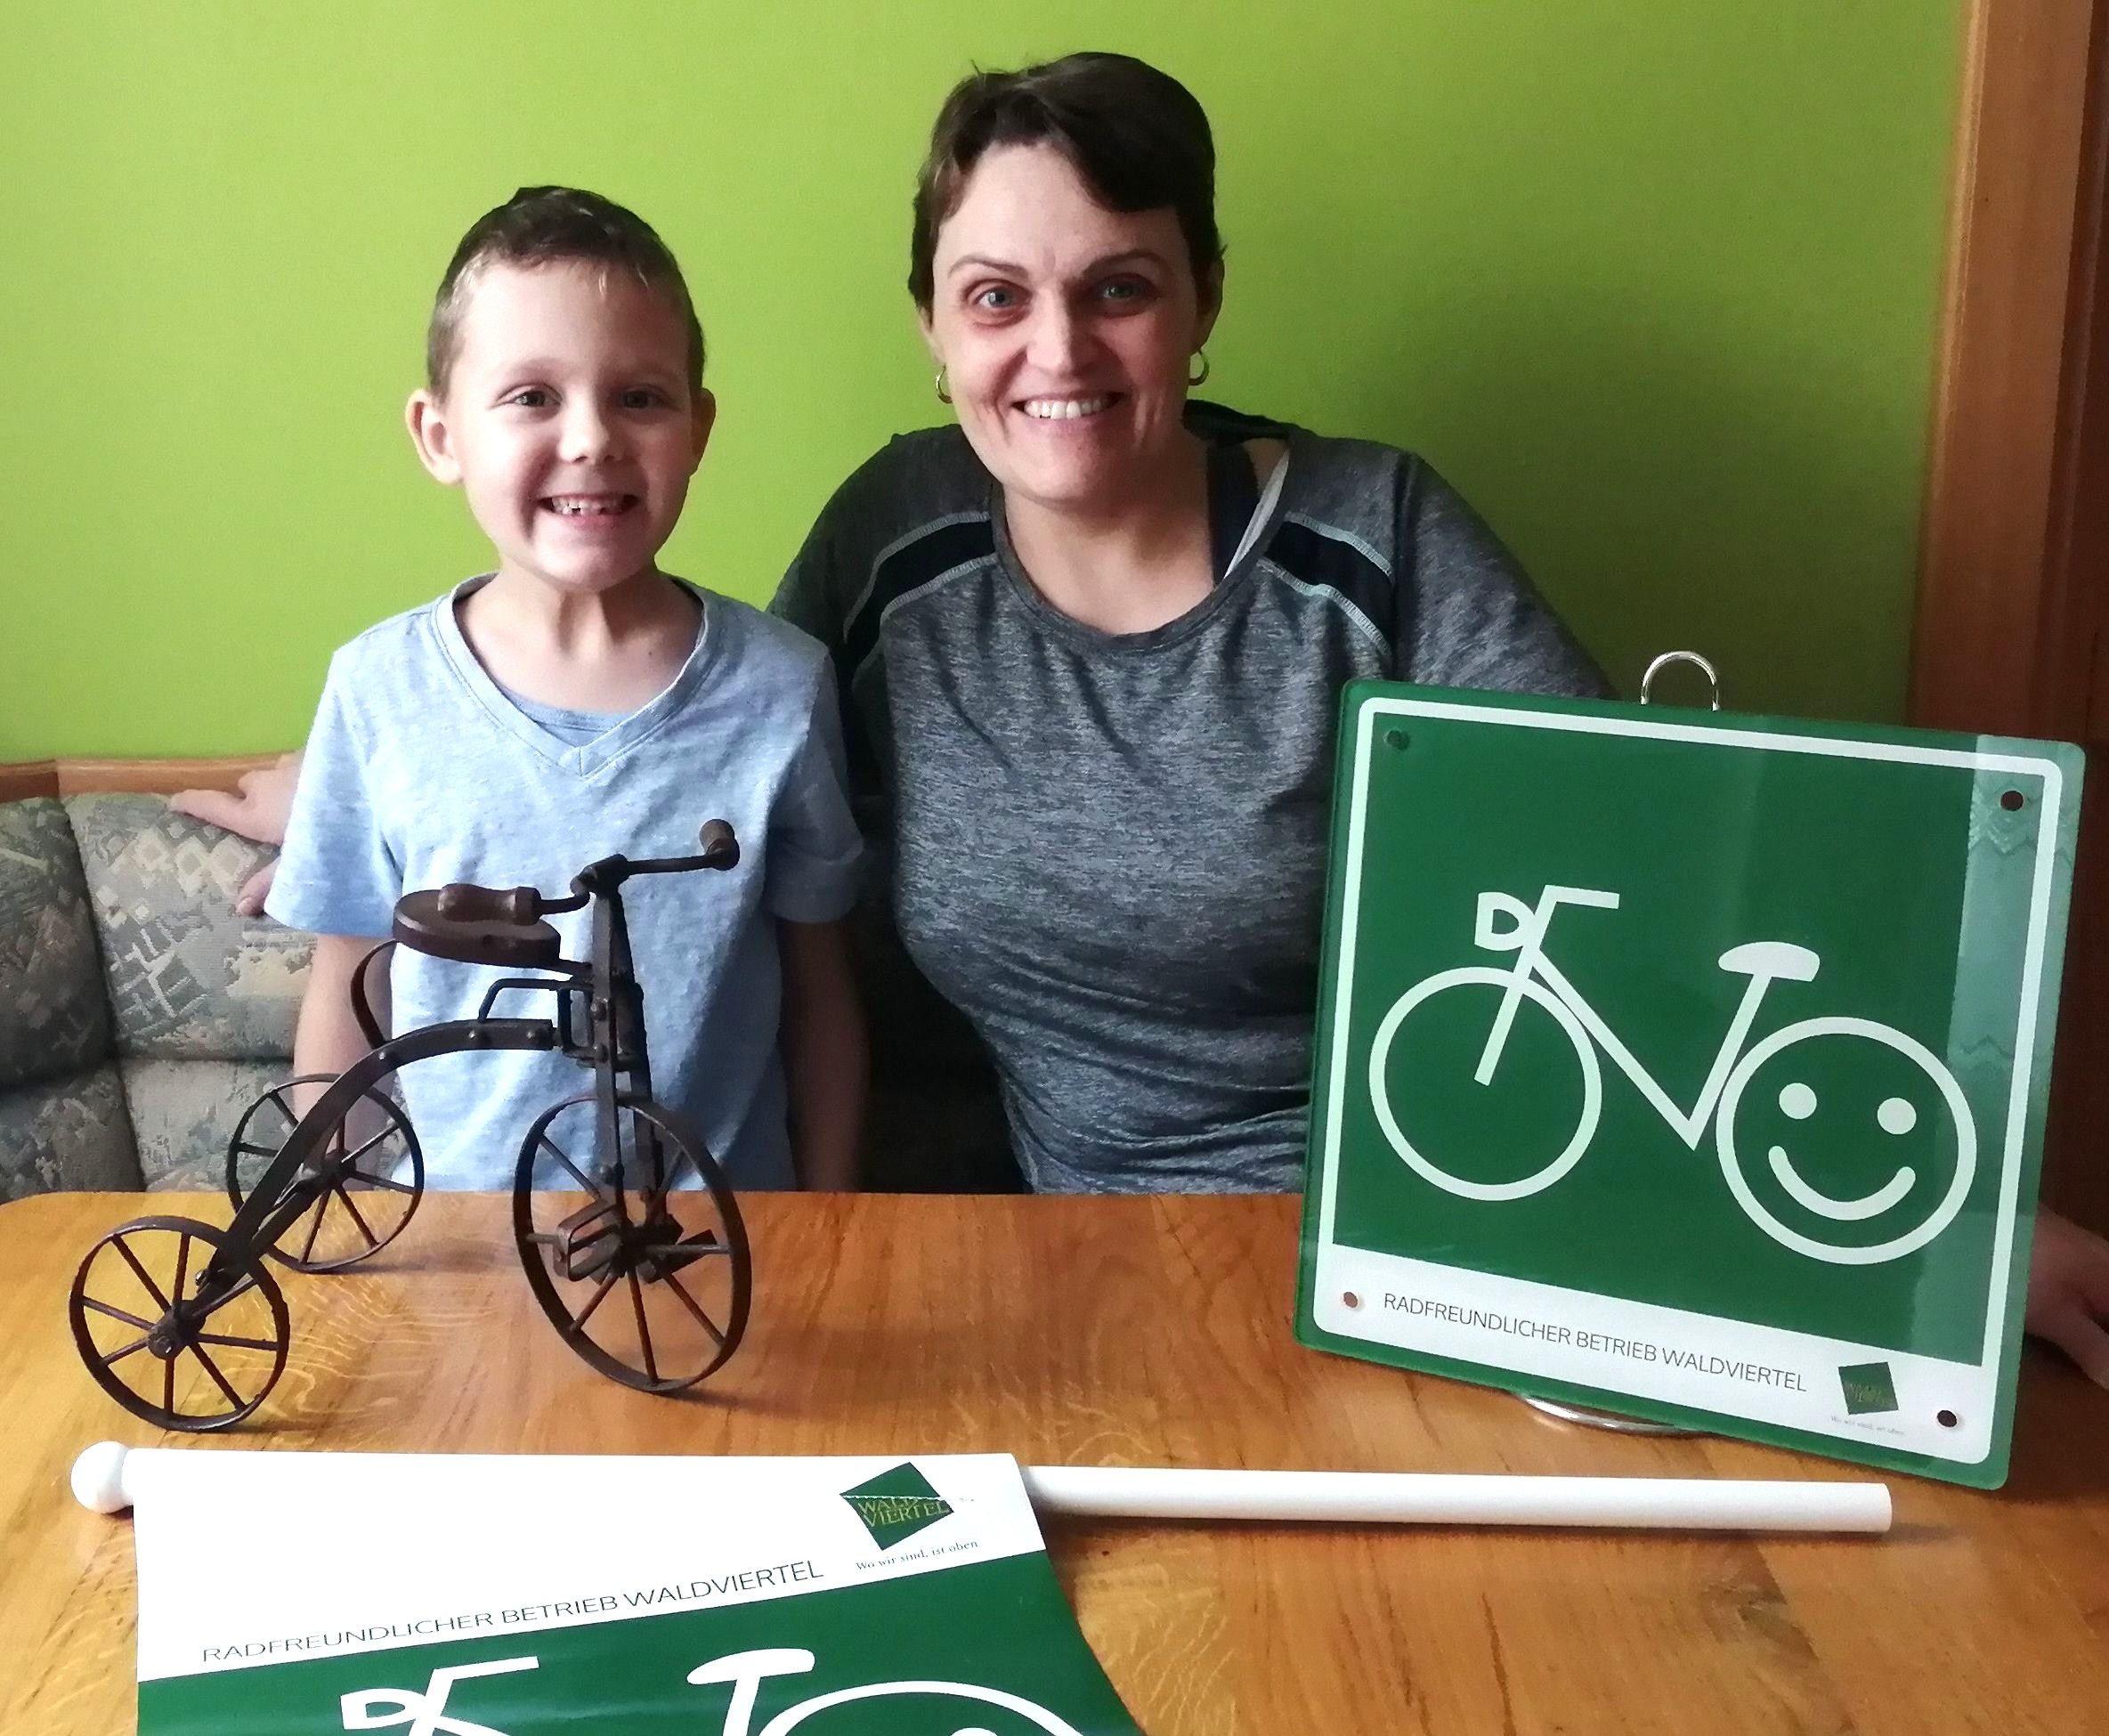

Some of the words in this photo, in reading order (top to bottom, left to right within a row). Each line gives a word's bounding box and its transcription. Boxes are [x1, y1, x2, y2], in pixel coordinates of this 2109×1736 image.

[1383, 1293, 1571, 1345] RADFREUNDLICHER
[1576, 1331, 1658, 1361] BETRIEB
[1662, 1347, 1807, 1392] WALDVIERTEL
[863, 1500, 951, 1528] VIERTEL
[856, 1561, 875, 1570] Wo
[878, 1556, 896, 1567] wir
[932, 1547, 945, 1556] ist
[948, 1540, 978, 1553] oben
[202, 1612, 494, 1662] RADFREUNDLICHER
[501, 1595, 619, 1624] BETRIEB
[623, 1560, 824, 1607] WALDVIERTEL
